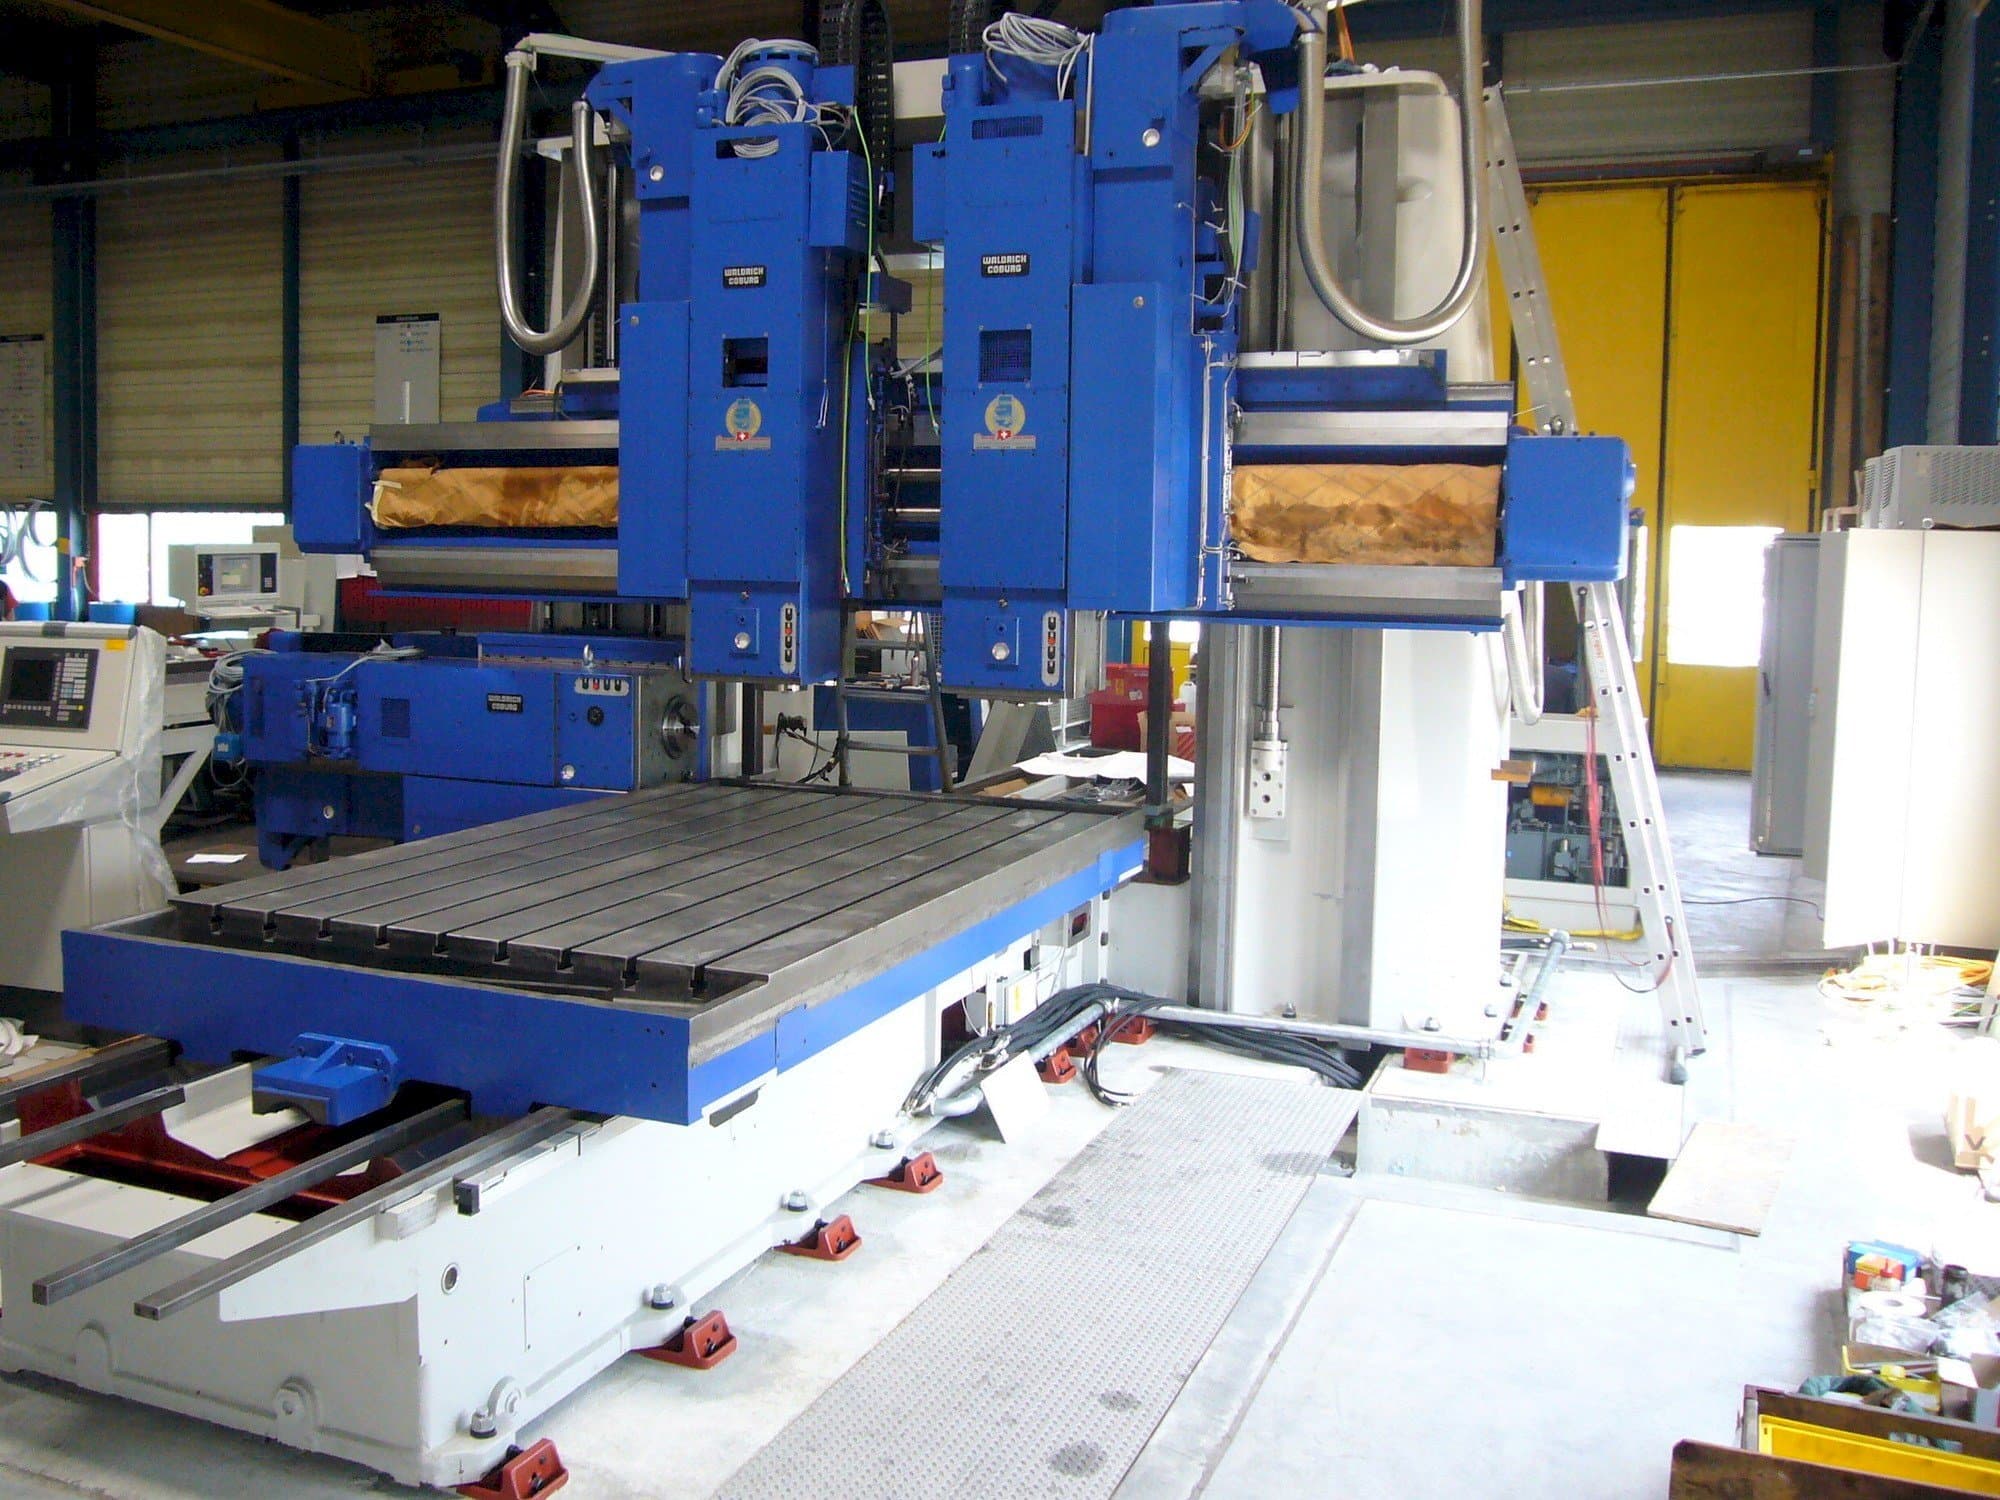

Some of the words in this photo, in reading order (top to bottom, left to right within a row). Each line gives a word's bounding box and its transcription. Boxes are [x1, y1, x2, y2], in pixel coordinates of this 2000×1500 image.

[982, 255, 1027, 265] WALDRICH
[724, 267, 764, 276] WALDRICH
[987, 264, 1022, 274] COBURG
[728, 276, 759, 285] COBURG
